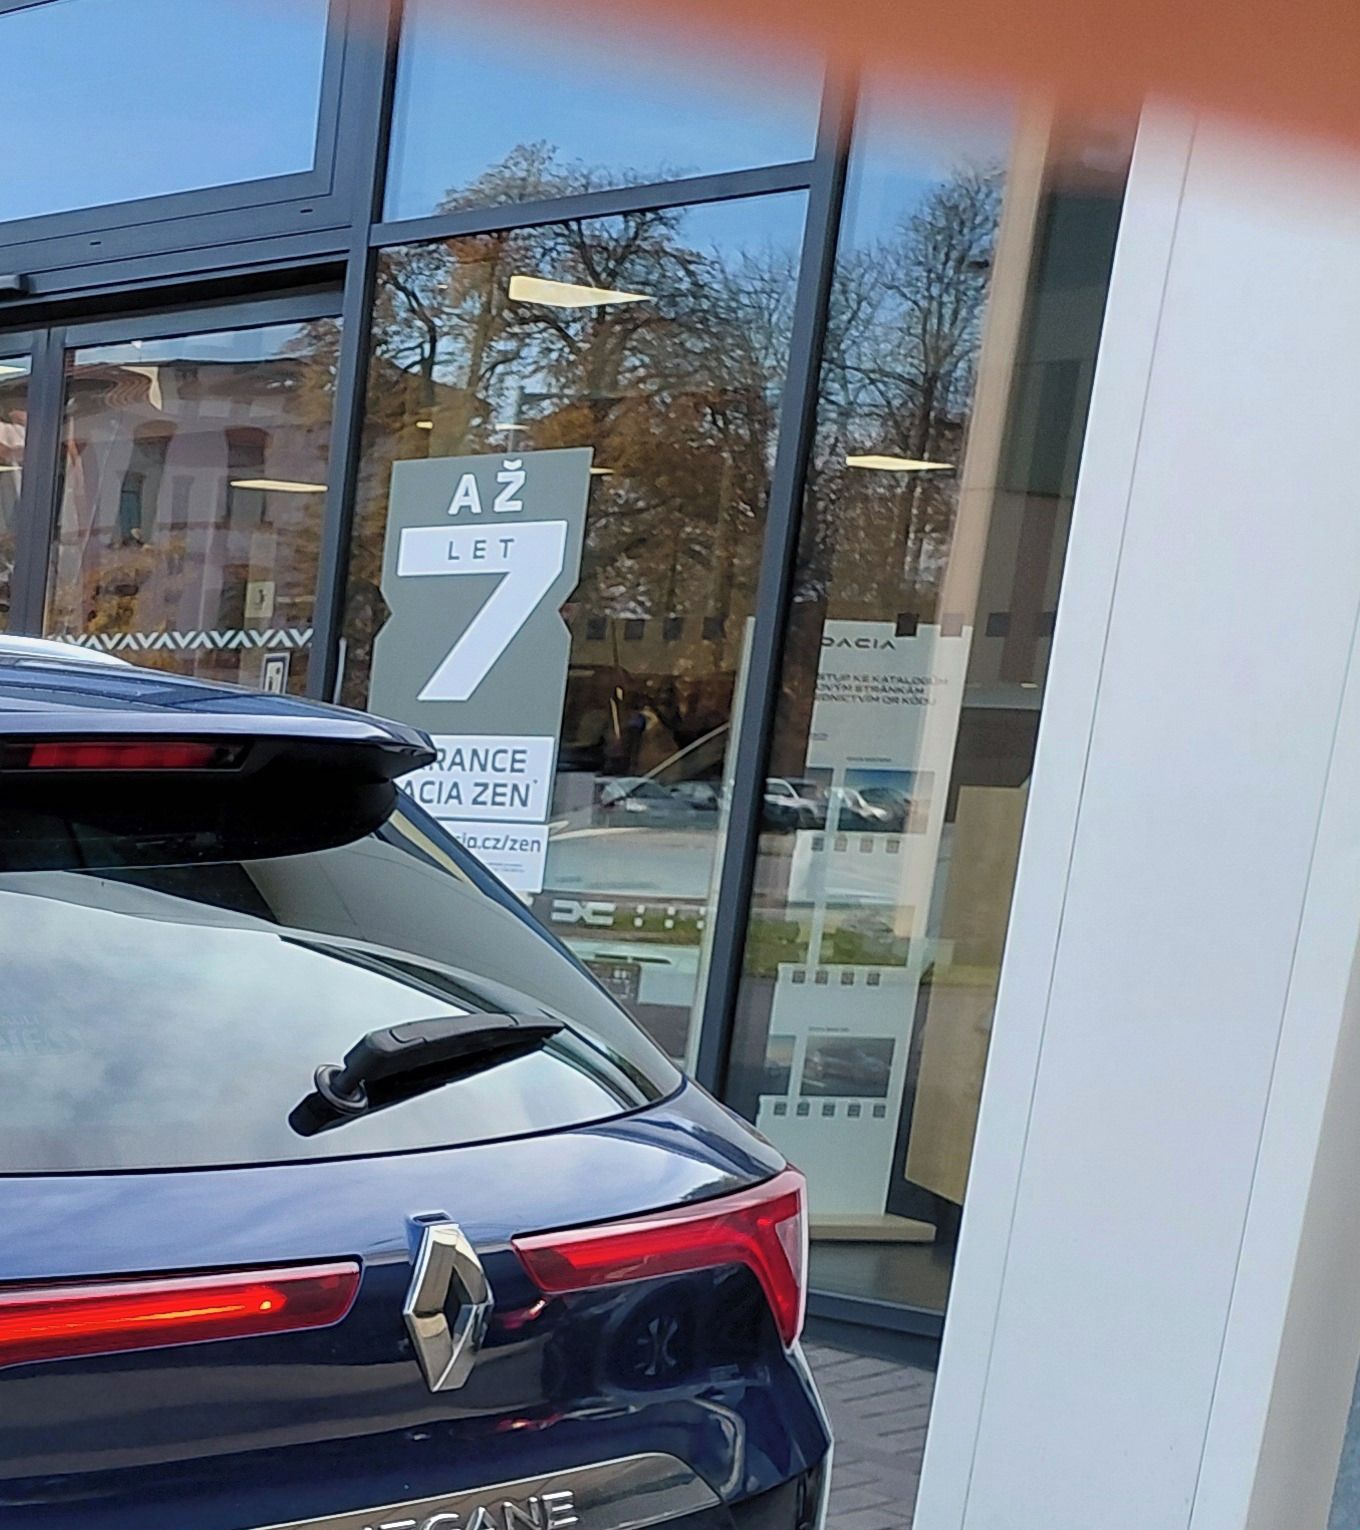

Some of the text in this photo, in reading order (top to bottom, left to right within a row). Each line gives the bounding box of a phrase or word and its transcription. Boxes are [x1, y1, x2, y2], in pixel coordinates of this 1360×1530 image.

[447, 458, 527, 516] AŽ
[447, 538, 515, 561] LET
[397, 520, 568, 701] 7
[820, 637, 897, 650] DACIA
[421, 748, 528, 774] RANCE
[402, 779, 463, 806] ACIA
[456, 831, 541, 853] ia.cz/zen
